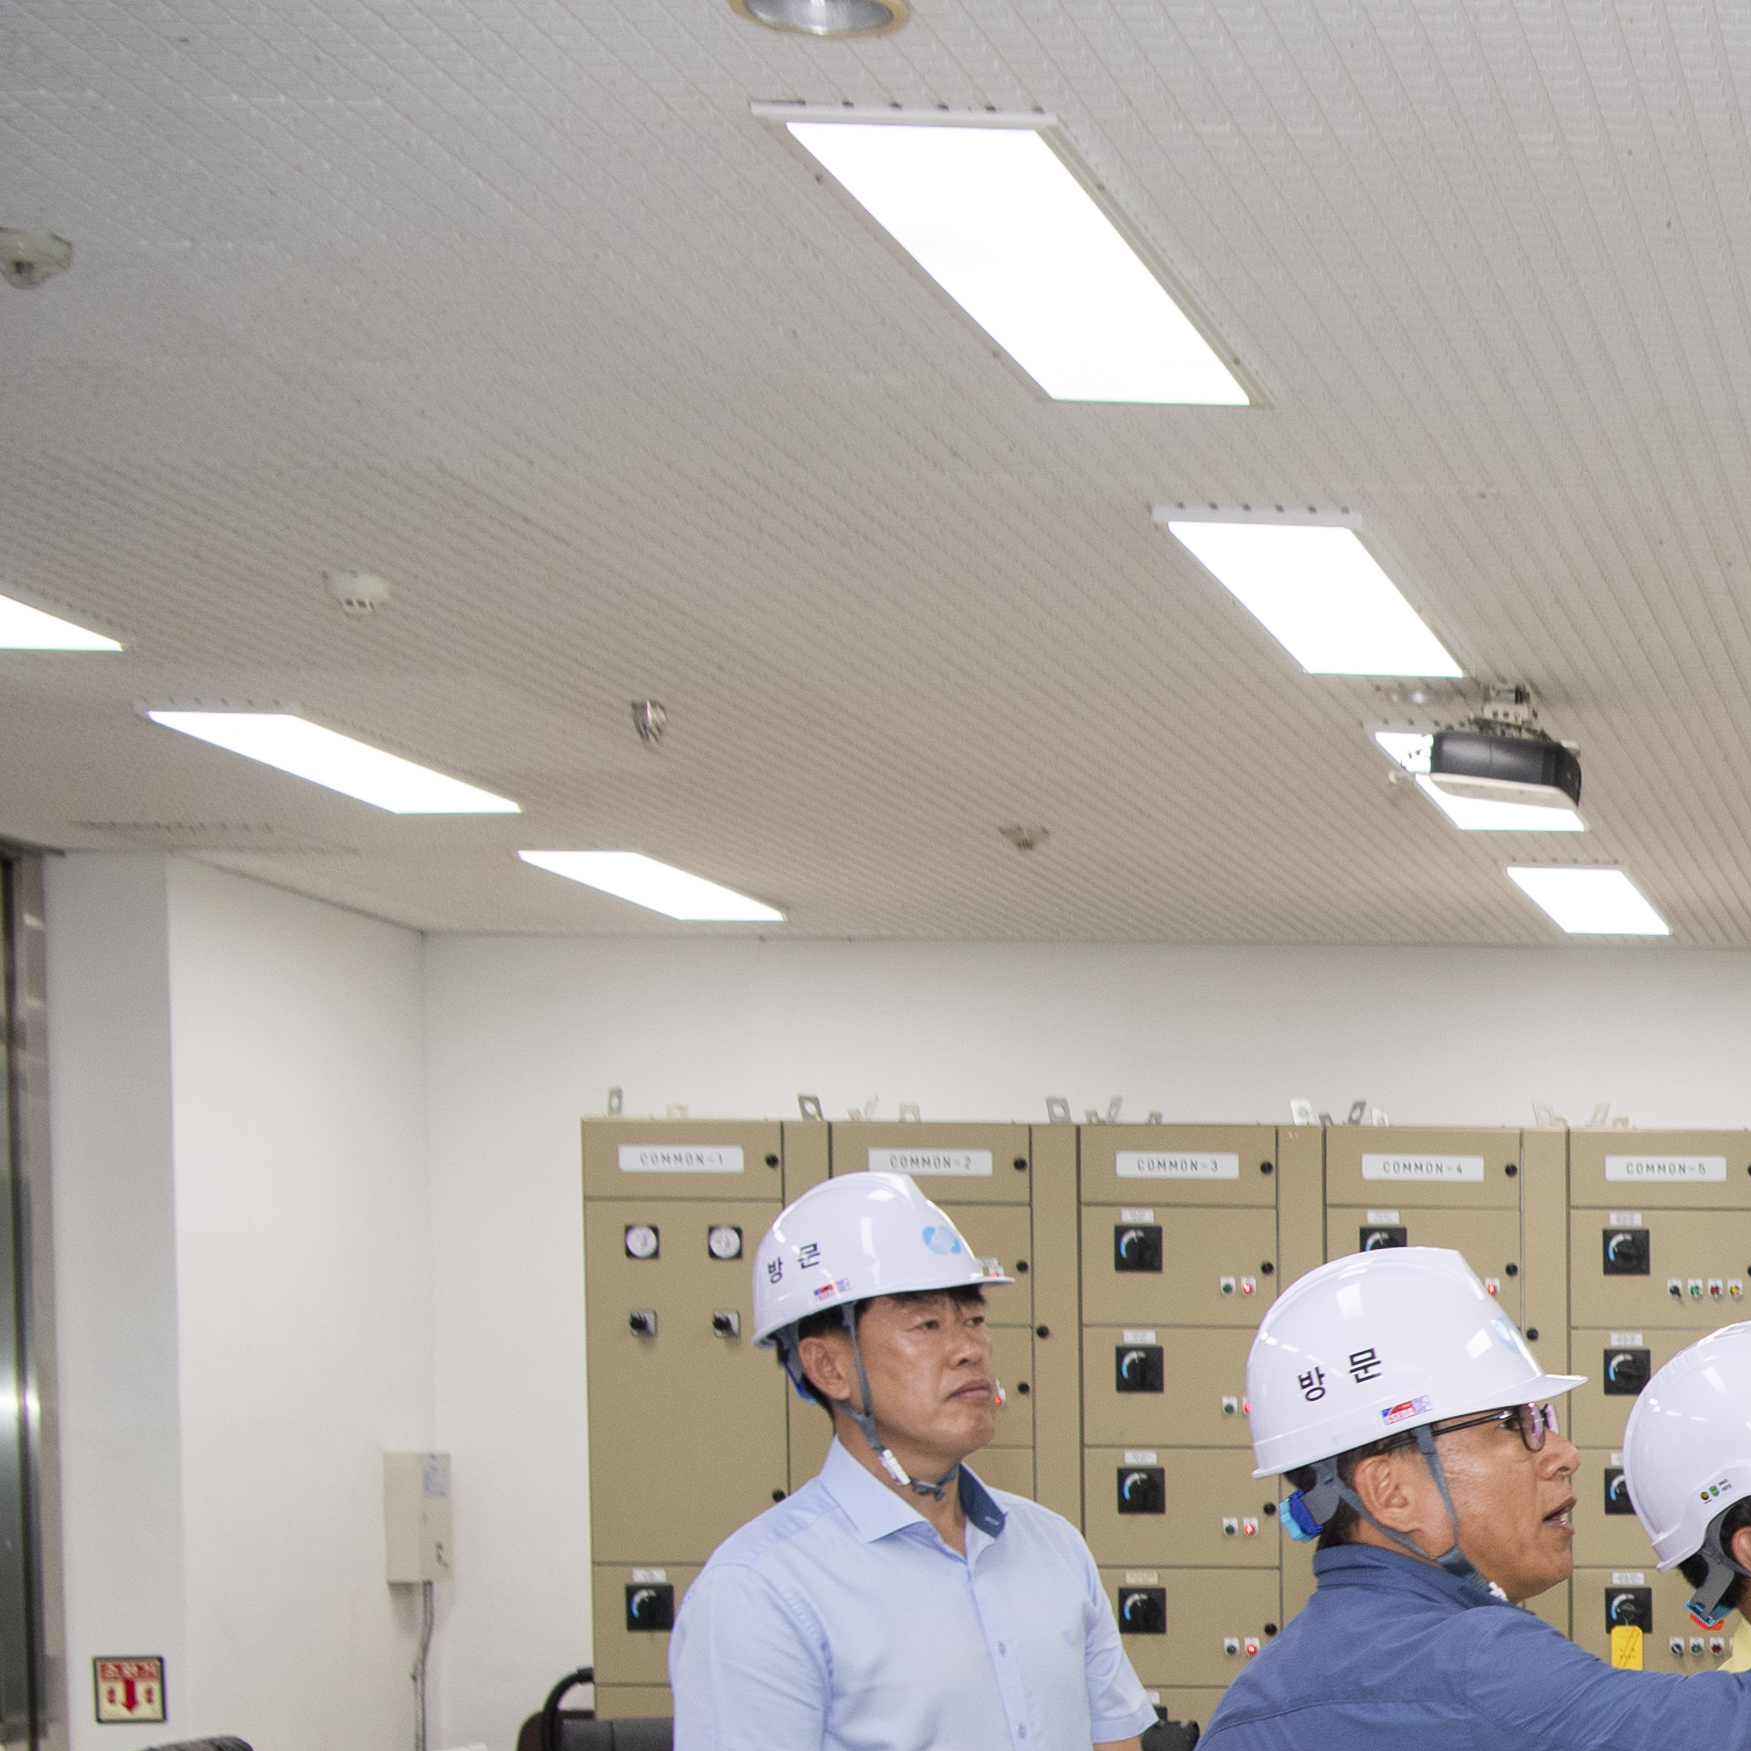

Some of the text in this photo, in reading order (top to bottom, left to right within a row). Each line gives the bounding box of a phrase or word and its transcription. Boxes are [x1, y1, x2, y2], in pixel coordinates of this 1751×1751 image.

[639, 1151, 723, 1167] COMMON-1
[887, 1154, 973, 1170] COMMON-2
[1135, 1157, 1220, 1173] COMMON-3
[1381, 1159, 1465, 1175] COMMON-4
[1624, 1161, 1708, 1176] COMMON-5
[766, 1242, 822, 1285] 방문
[1297, 1346, 1384, 1403] 방문
